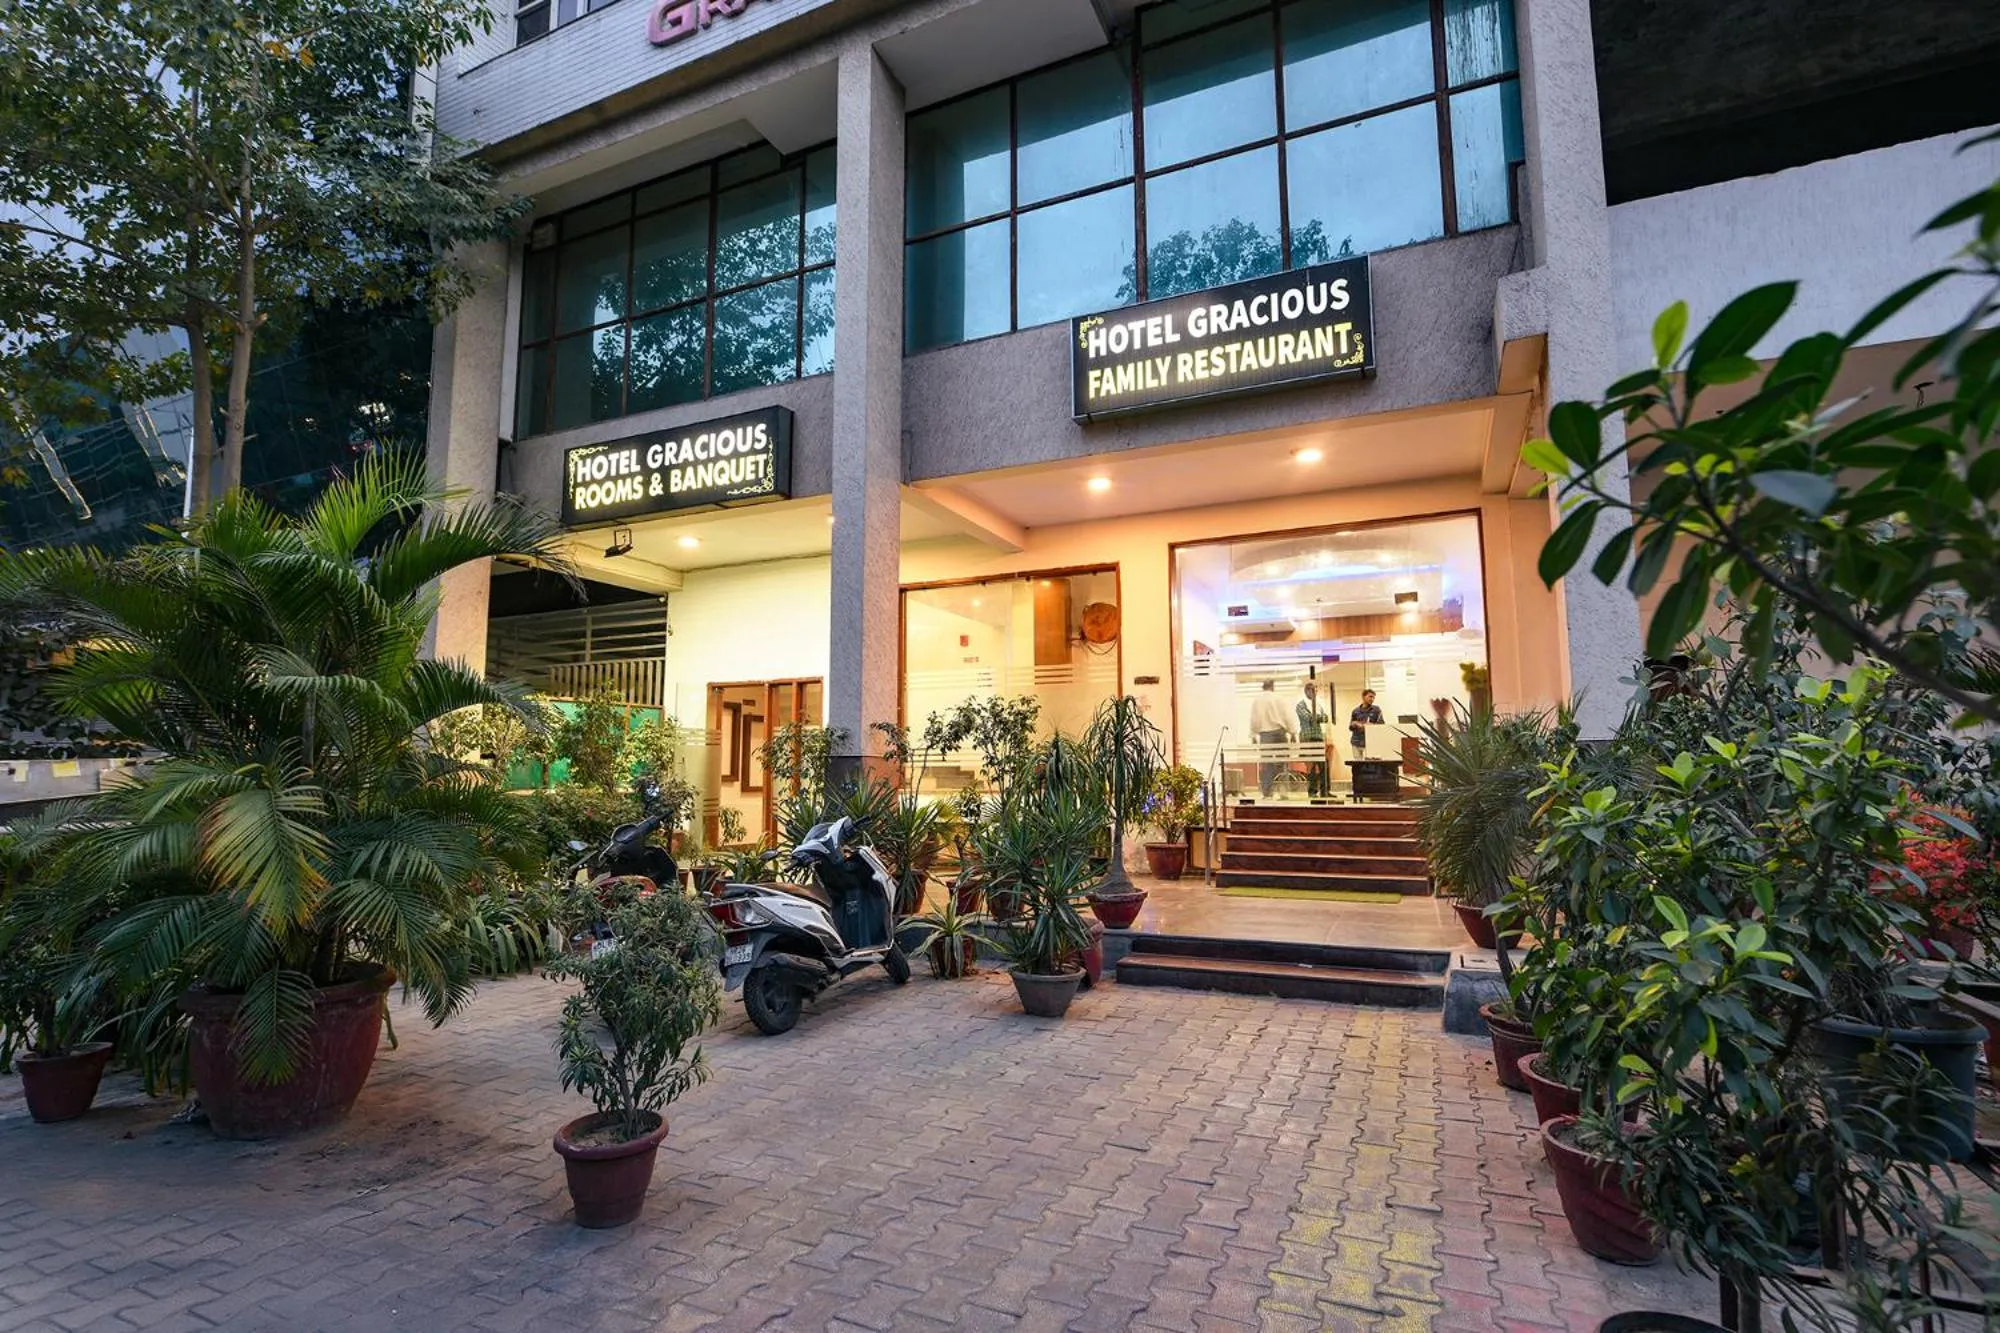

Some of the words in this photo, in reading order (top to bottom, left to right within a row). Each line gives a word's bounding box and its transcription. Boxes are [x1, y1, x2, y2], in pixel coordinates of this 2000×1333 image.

[1088, 314, 1181, 359] HOTEL
[1186, 277, 1351, 338] GRACIOUS
[1088, 355, 1172, 400] FAMILY
[1176, 321, 1354, 384] RESTAURANT
[574, 477, 644, 510] ROOMS
[648, 472, 664, 497] &
[669, 453, 768, 493] BANQUET
[576, 450, 641, 483] HOTEL
[646, 423, 768, 469] GRACIOUS
